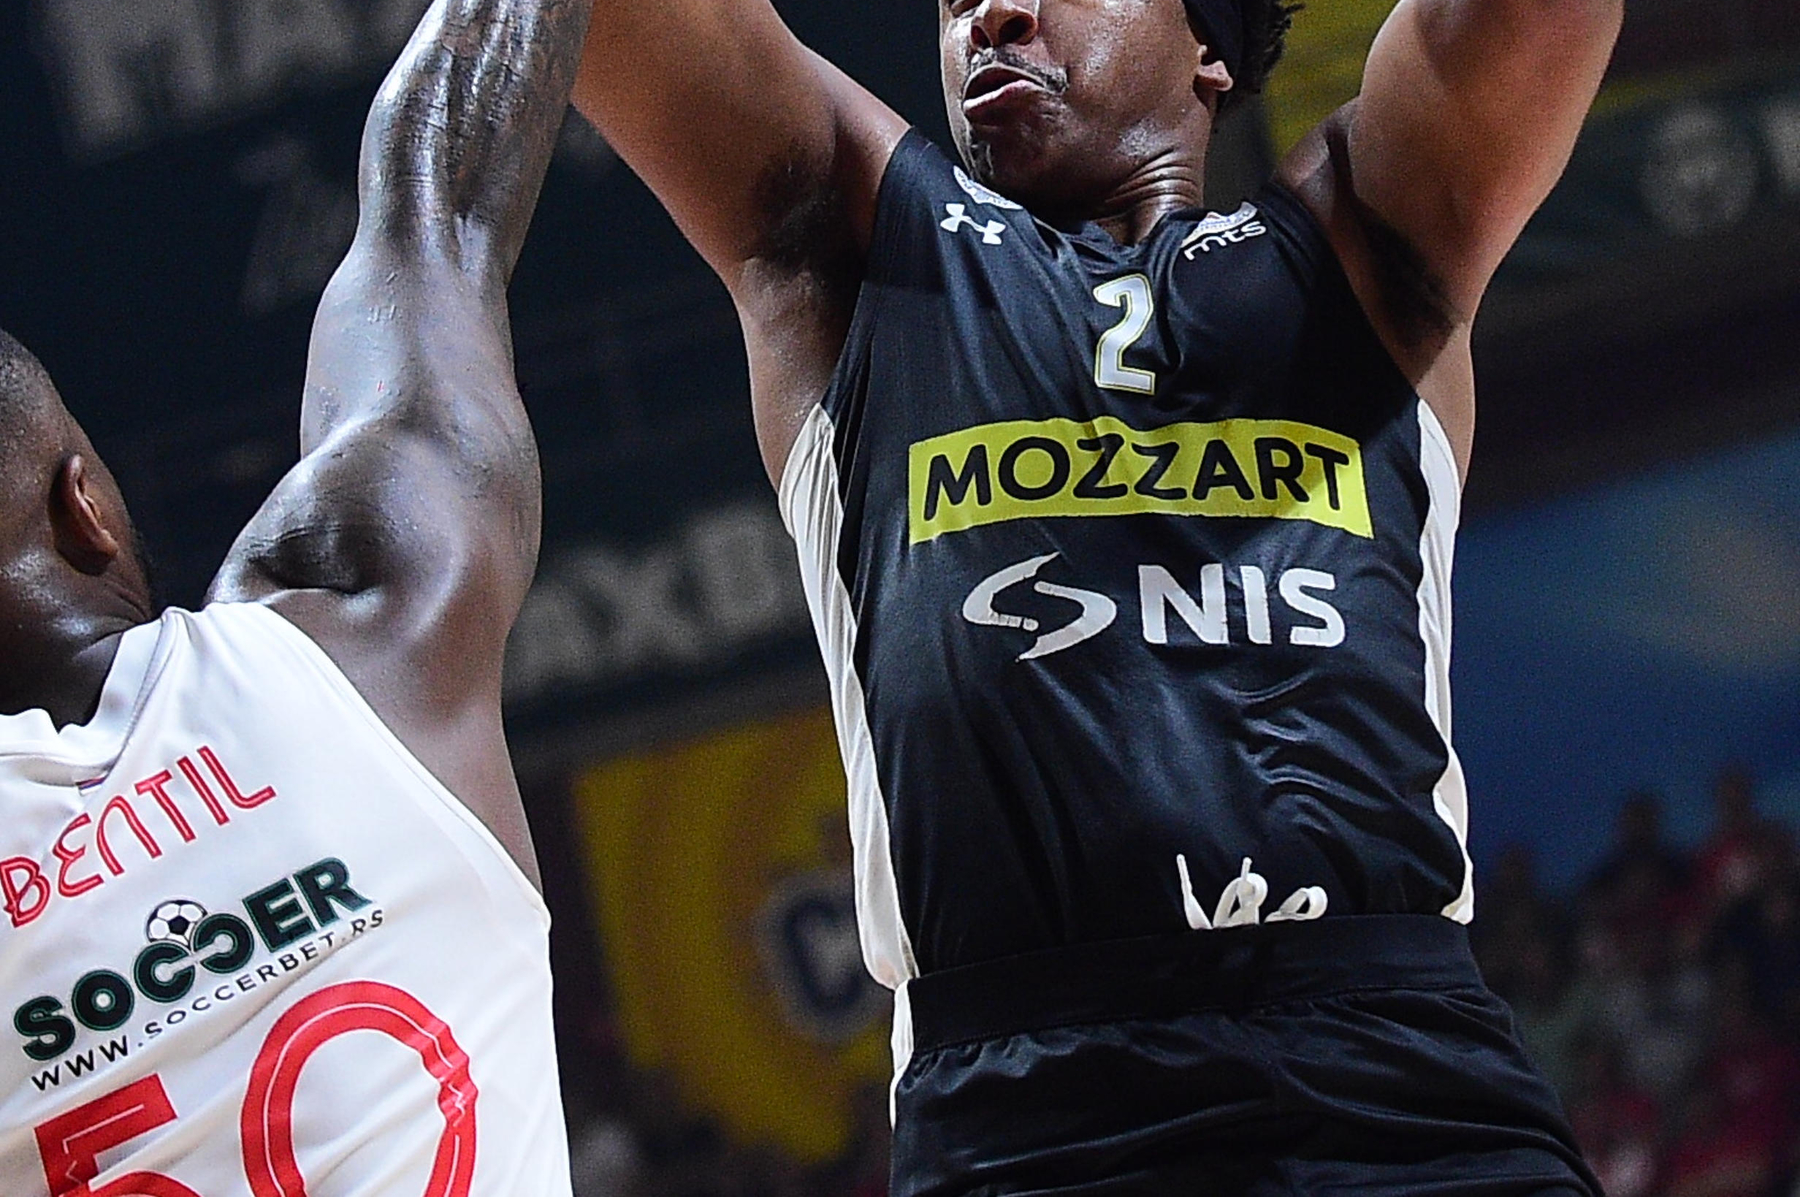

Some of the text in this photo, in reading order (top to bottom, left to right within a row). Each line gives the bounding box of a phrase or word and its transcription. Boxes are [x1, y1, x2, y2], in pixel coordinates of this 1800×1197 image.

[1184, 220, 1266, 261] mts
[1093, 273, 1156, 396] 2
[923, 433, 1349, 522] MOZZART
[1137, 563, 1346, 649] NIS
[12, 856, 373, 1061] SOCCER
[31, 908, 386, 1092] WWW.SOCCERBET.RS
